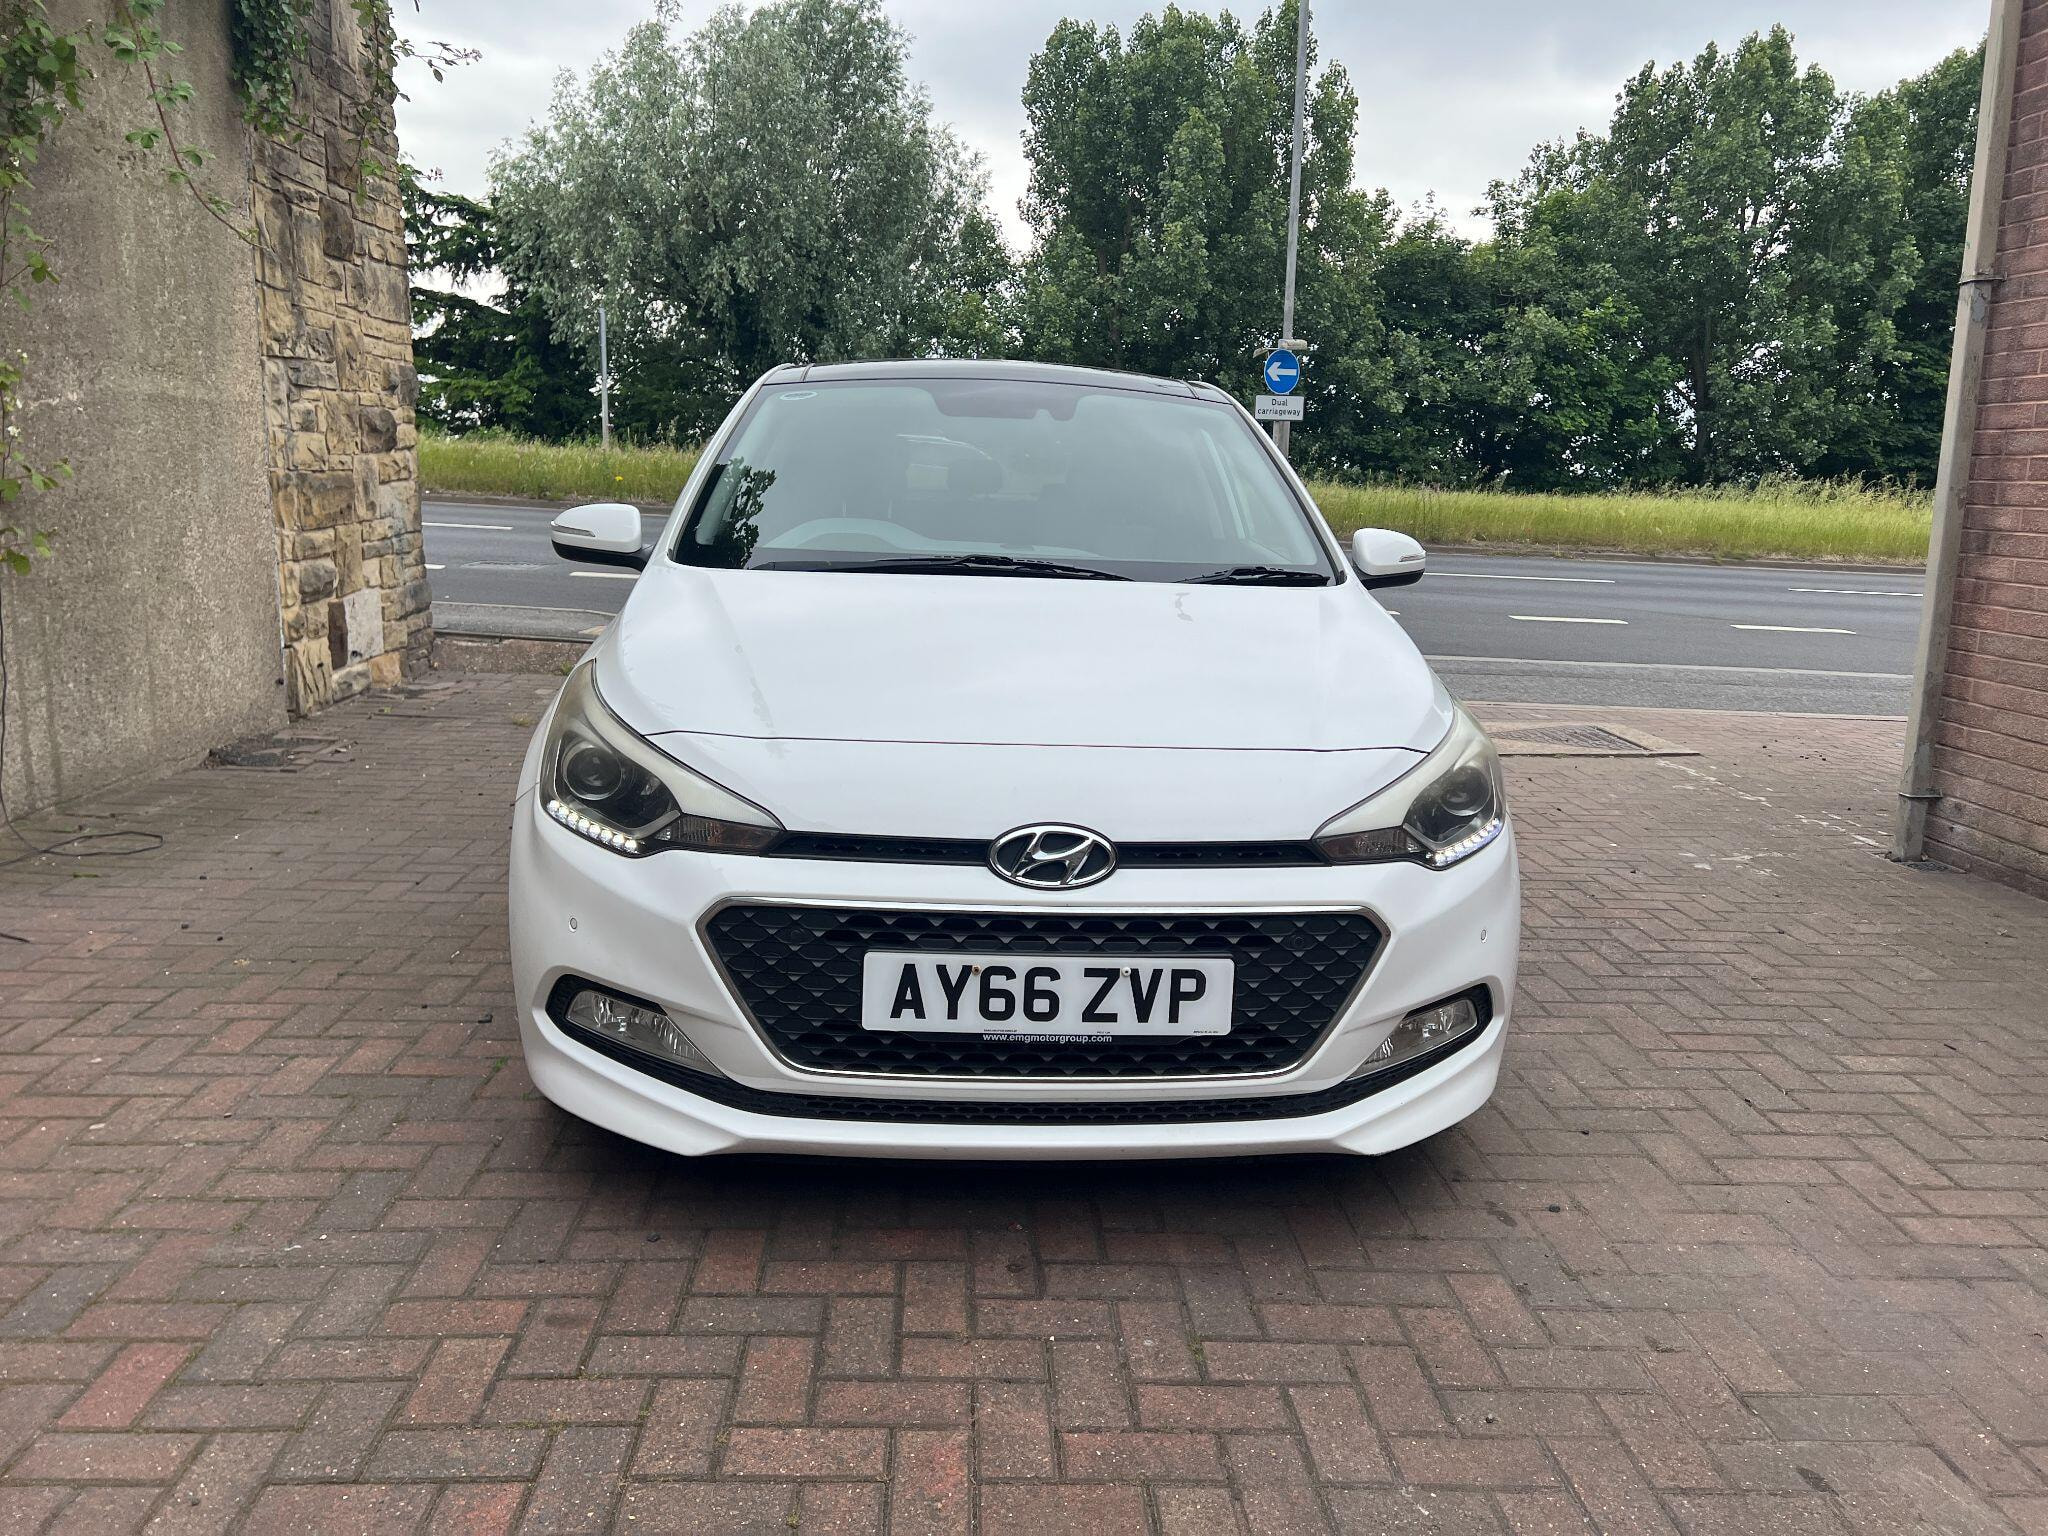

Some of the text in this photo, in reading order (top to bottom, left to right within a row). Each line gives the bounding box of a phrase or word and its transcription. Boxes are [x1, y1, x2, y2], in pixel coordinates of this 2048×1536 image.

[1257, 408, 1301, 416] carriageway
[890, 963, 1207, 1023] AY66 ZVP
[983, 1034, 1112, 1043] www.emgmotorgroup.com
